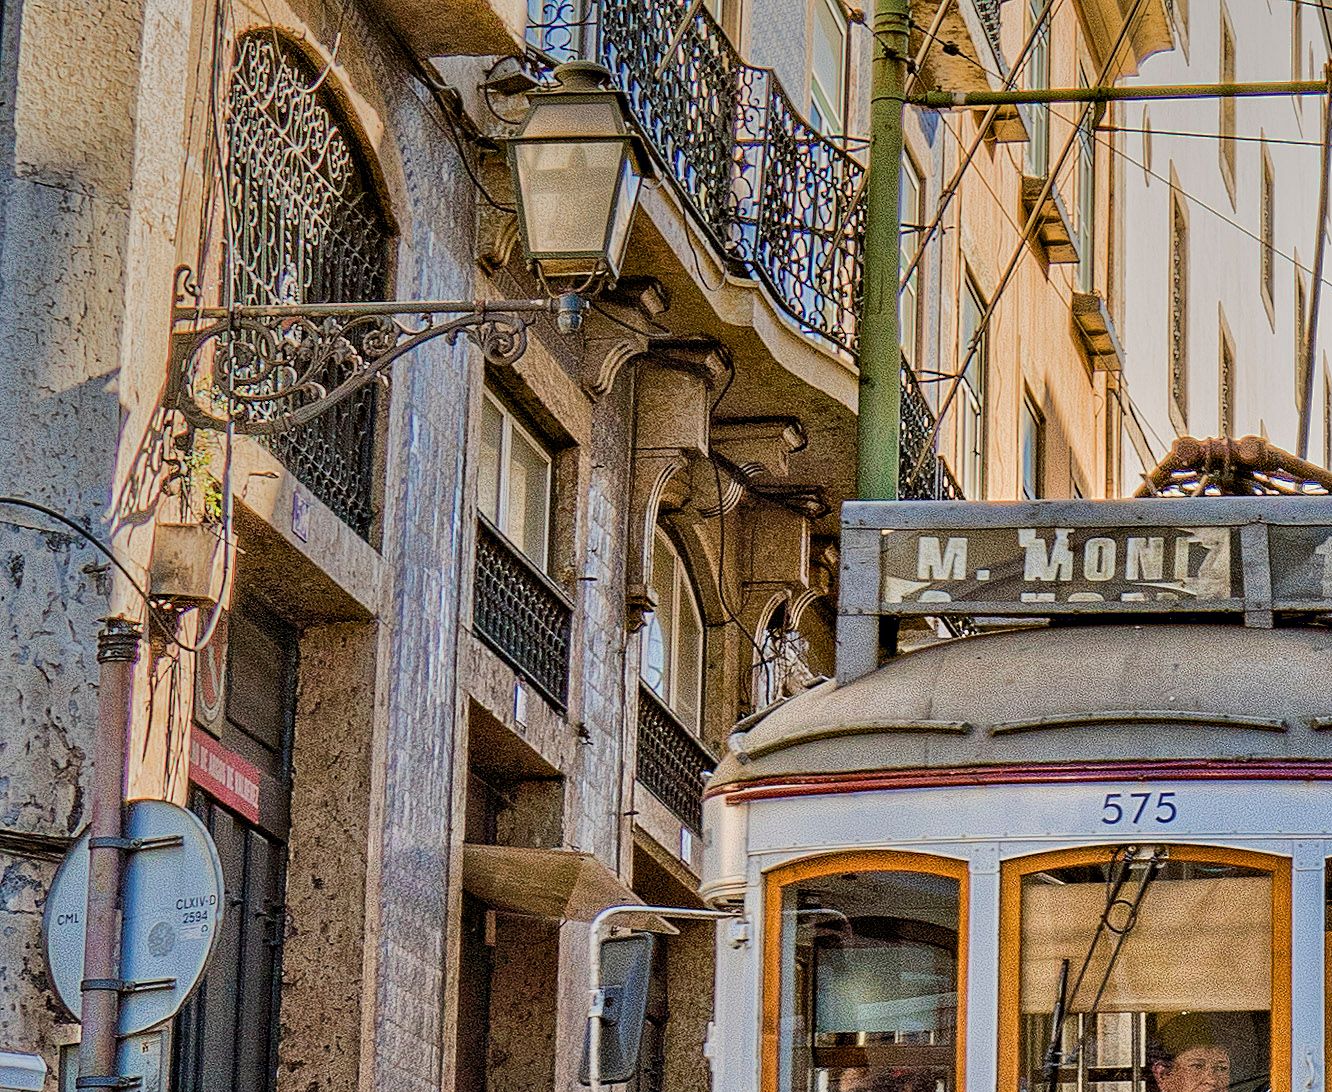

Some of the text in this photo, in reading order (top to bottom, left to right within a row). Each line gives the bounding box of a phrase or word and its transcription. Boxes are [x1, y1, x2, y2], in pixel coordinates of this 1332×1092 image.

[917, 536, 990, 581] M.
[1101, 792, 1178, 825] 575
[176, 894, 216, 910] CLXIV-D
[57, 915, 79, 926] CML
[182, 911, 208, 924] 2594
